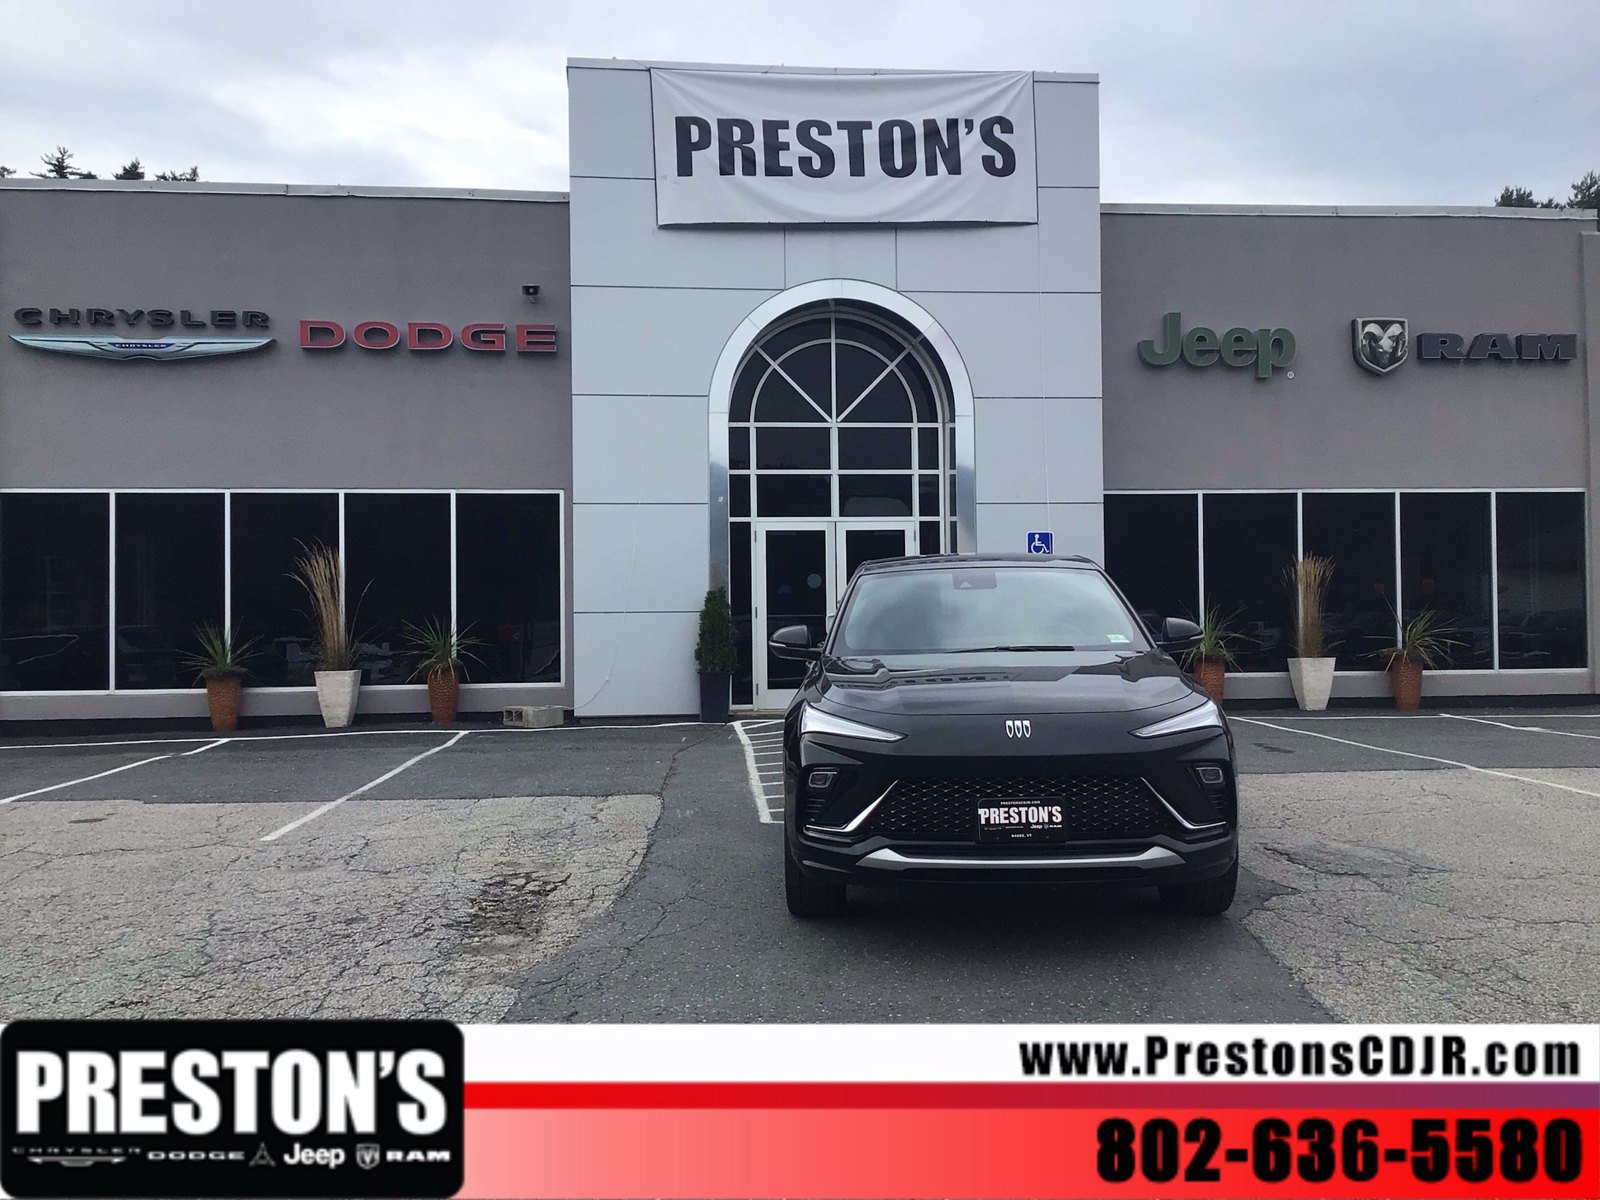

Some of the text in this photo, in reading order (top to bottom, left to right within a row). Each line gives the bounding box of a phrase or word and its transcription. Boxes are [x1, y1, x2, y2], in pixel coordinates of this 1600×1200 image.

[675, 115, 1016, 178] PRESTON'S
[14, 307, 271, 328] CHRYSLER
[300, 320, 558, 352] DODGE
[1137, 312, 1296, 379] Jeep
[1417, 332, 1577, 361] RAM
[978, 805, 1062, 824] PRESTON'S
